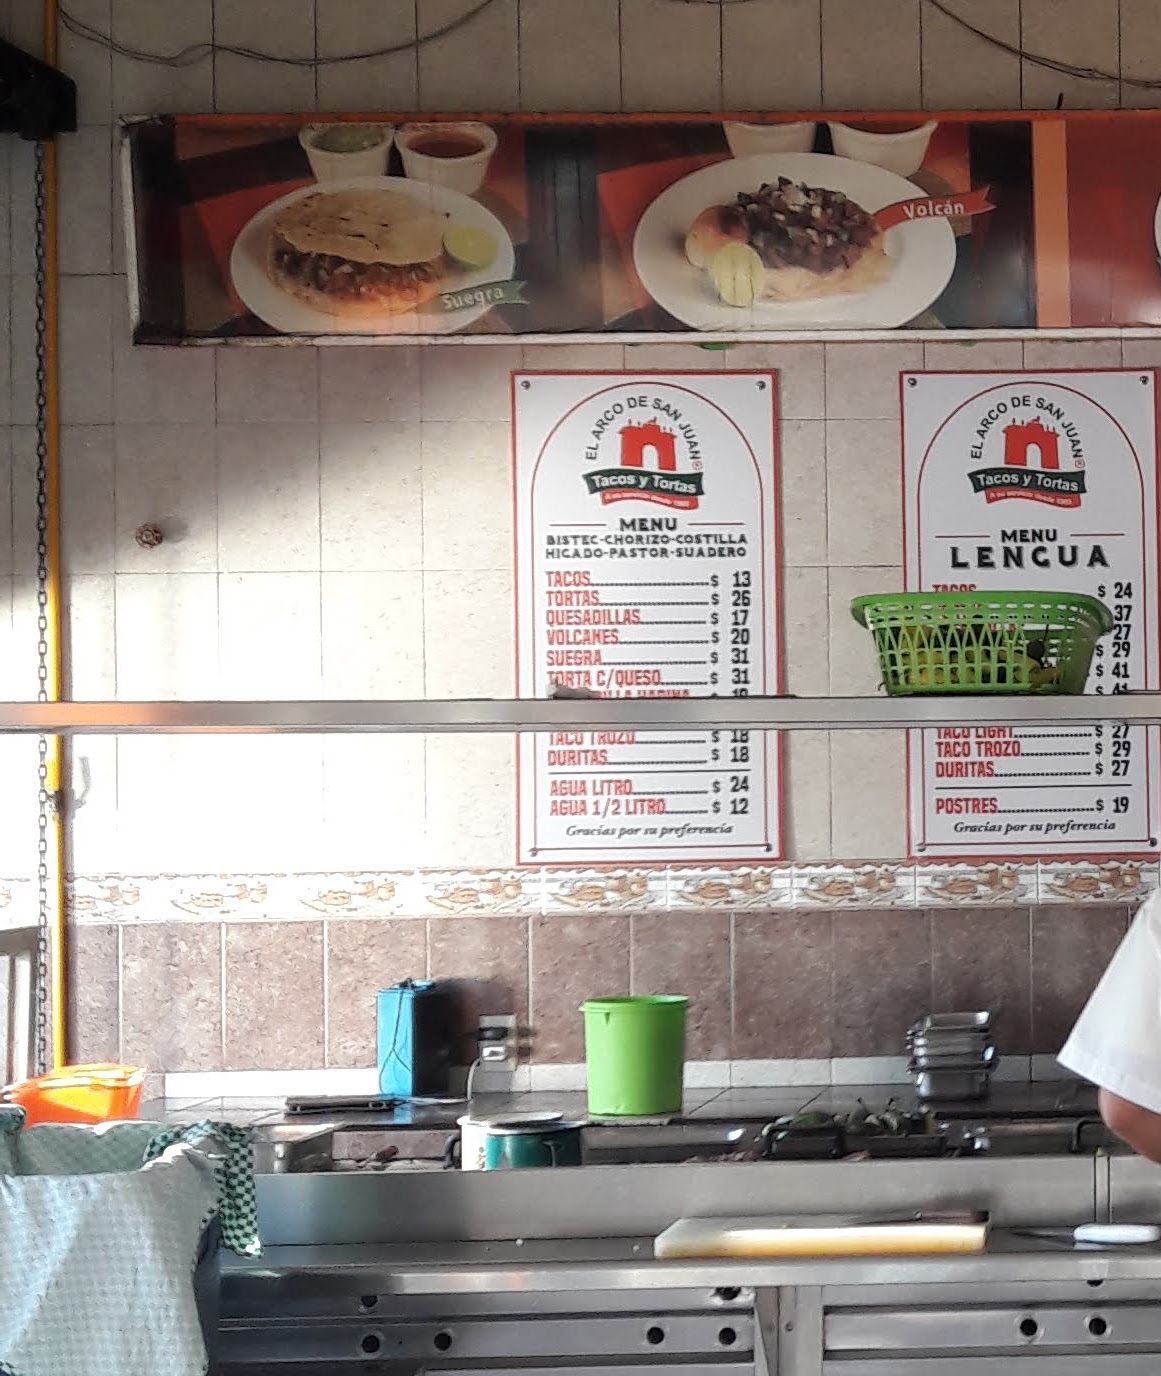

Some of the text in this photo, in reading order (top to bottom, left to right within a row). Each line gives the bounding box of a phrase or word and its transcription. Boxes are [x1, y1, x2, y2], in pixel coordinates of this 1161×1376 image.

[902, 200, 964, 220] Volcán
[441, 287, 504, 310] Suegra
[585, 395, 701, 460] EL ARCO DE SAN JUAN
[971, 395, 1083, 459] EL ARCO DE SAN JUAN
[592, 474, 697, 493] Tacos y Tortas
[977, 473, 1079, 491] Tacos y Tortas
[619, 517, 678, 532] MENU
[1000, 529, 1057, 542] MENU
[950, 545, 1110, 568] LENGUA
[546, 571, 590, 587] TACOS
[732, 571, 751, 587] 13
[546, 590, 600, 607] TORTAS
[732, 590, 751, 606] 26
[1114, 582, 1133, 599] 24
[546, 609, 640, 626] QUESADILLAS
[731, 609, 749, 625] 17
[1114, 605, 1132, 621] 37
[546, 629, 619, 645] VOLCANES
[731, 628, 750, 644] 20
[1113, 624, 1131, 640] 27
[546, 649, 602, 666] SUEGRA
[731, 647, 750, 664] 31
[1112, 642, 1131, 658] 29
[546, 670, 591, 687] TORTA
[596, 668, 661, 689] C/QUESO
[731, 668, 750, 684] 31
[1112, 662, 1130, 678] 41
[548, 749, 608, 766] DURITAS
[730, 746, 749, 762] 18
[936, 741, 971, 757] TACO
[976, 741, 1021, 757] TROZO
[1112, 741, 1131, 757] 29
[936, 761, 994, 778] DURITAS
[1112, 760, 1130, 776] 27
[550, 780, 587, 796] AGUA
[593, 779, 632, 796] LITRO
[730, 776, 749, 792] 24
[550, 799, 587, 816] AGUA
[593, 798, 621, 818] 1/2
[625, 798, 666, 815] LITRO
[730, 798, 749, 814] 12
[935, 797, 998, 815] POSTRES
[1112, 797, 1130, 813] 19
[566, 824, 614, 836] Gracias
[617, 827, 640, 839] por
[658, 823, 734, 839] preferencia
[953, 821, 1001, 833] Gracias
[1004, 824, 1027, 835] por
[1044, 819, 1116, 834] preferencia
